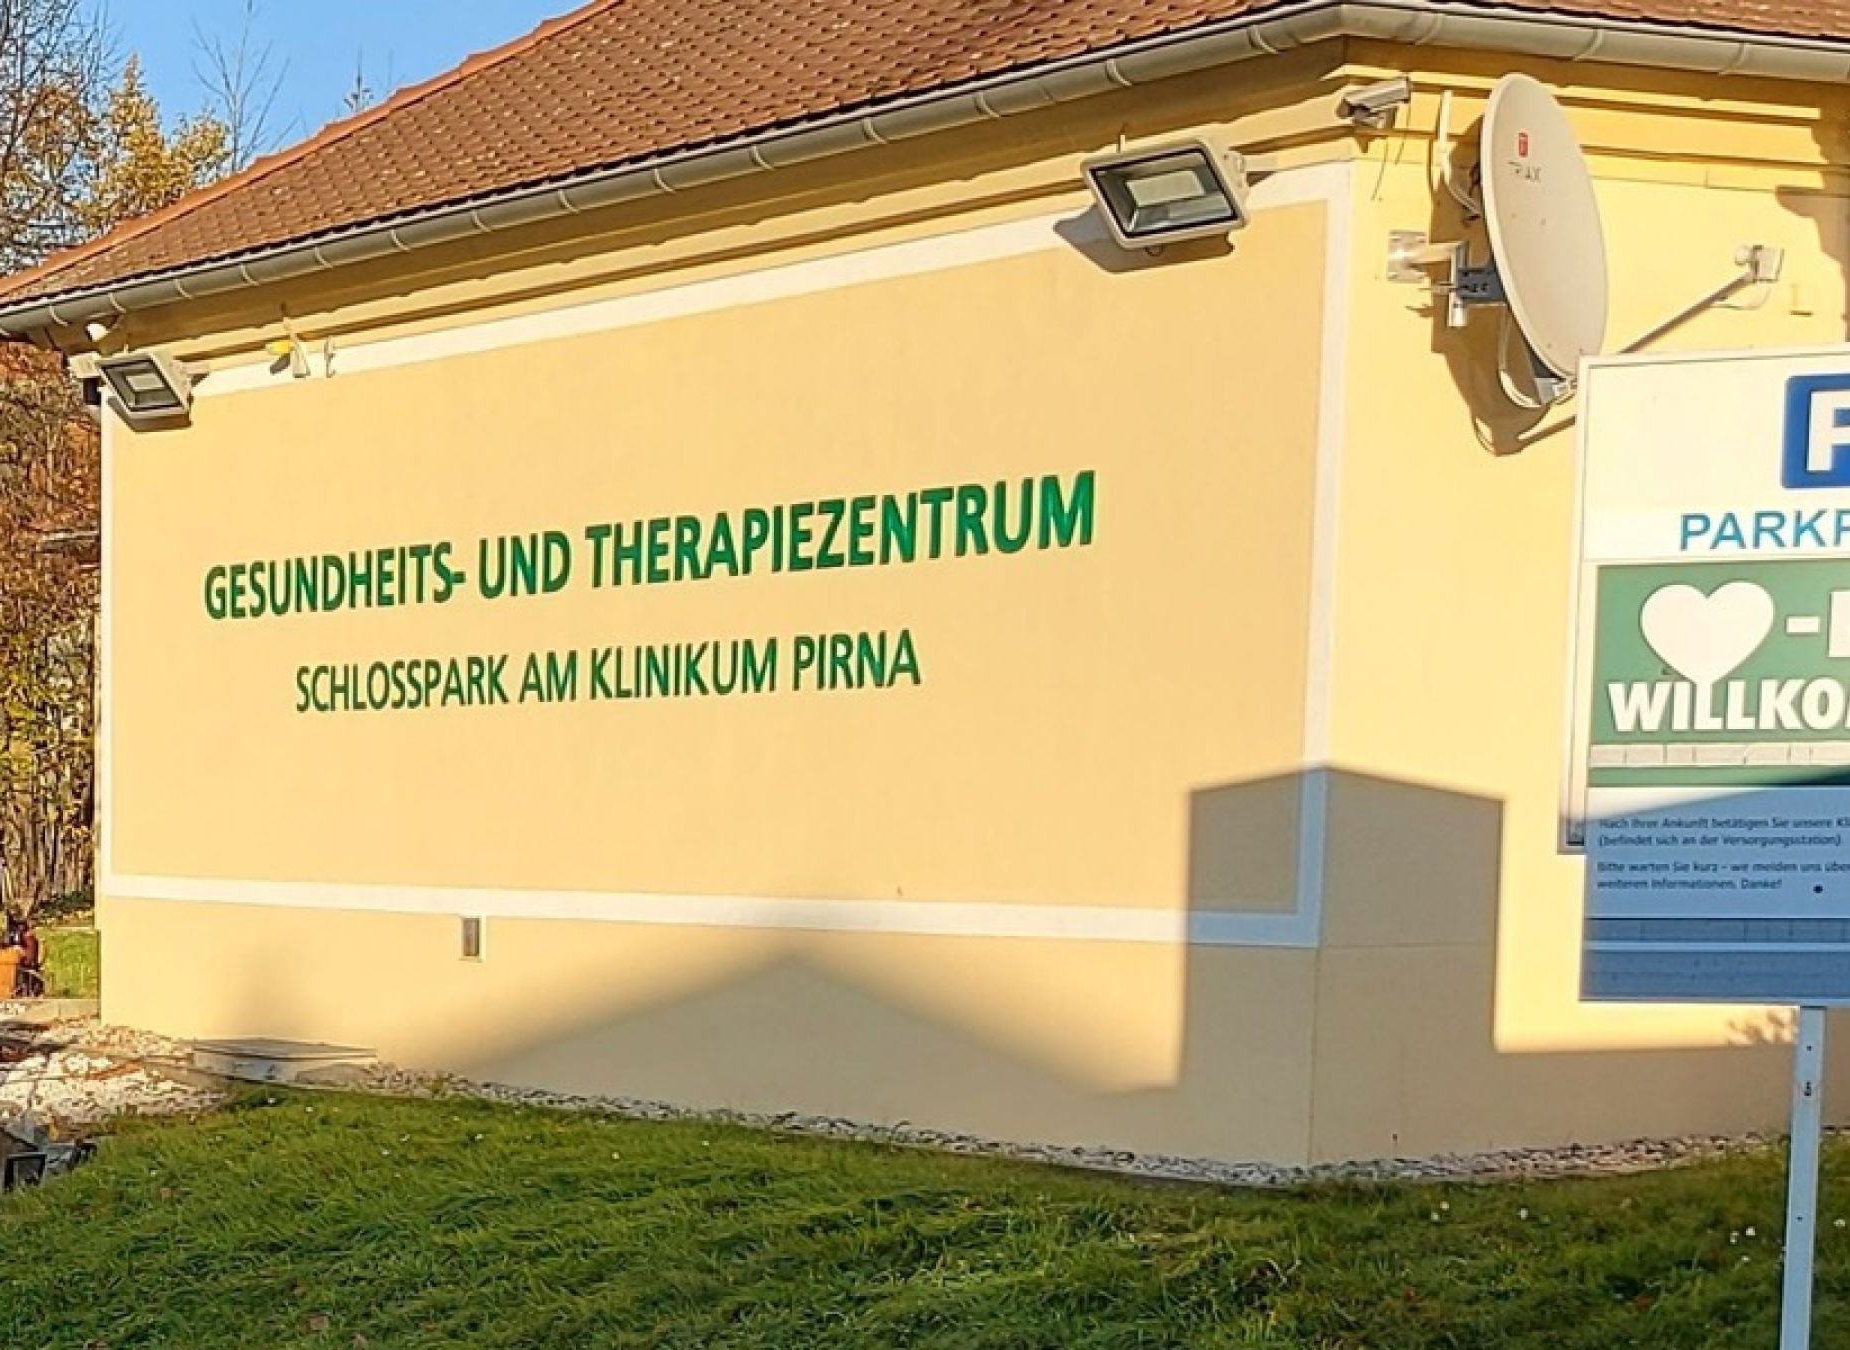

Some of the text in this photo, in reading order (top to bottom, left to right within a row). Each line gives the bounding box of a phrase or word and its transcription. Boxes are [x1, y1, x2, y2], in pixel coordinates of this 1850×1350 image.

[205, 470, 1096, 620] GESUNDHEITS- UND THERAPIEZENTRUM
[296, 628, 921, 713] SCHLOSSPARK AM KLINIKUM PIRNA
[1608, 676, 1850, 732] WILLKO
